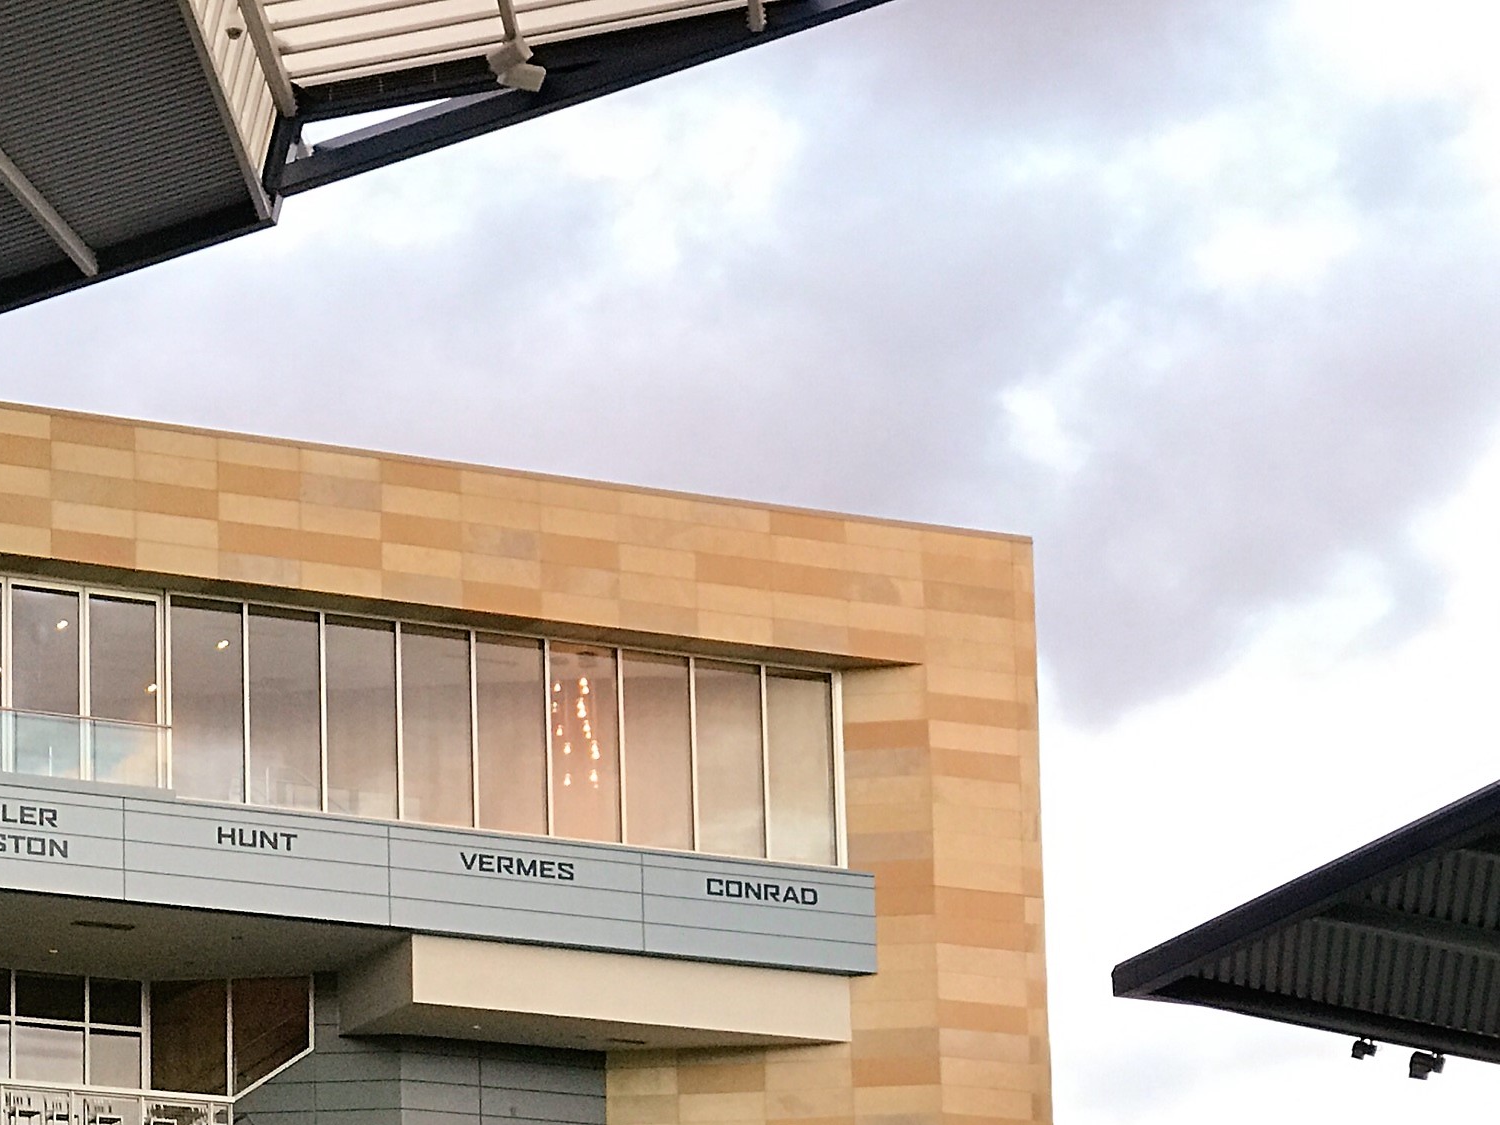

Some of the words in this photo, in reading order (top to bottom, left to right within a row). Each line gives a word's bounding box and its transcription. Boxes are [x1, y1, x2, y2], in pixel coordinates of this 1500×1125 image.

[216, 825, 298, 852] HUNT
[459, 852, 575, 881] VERMES
[706, 877, 819, 906] CONRAD
